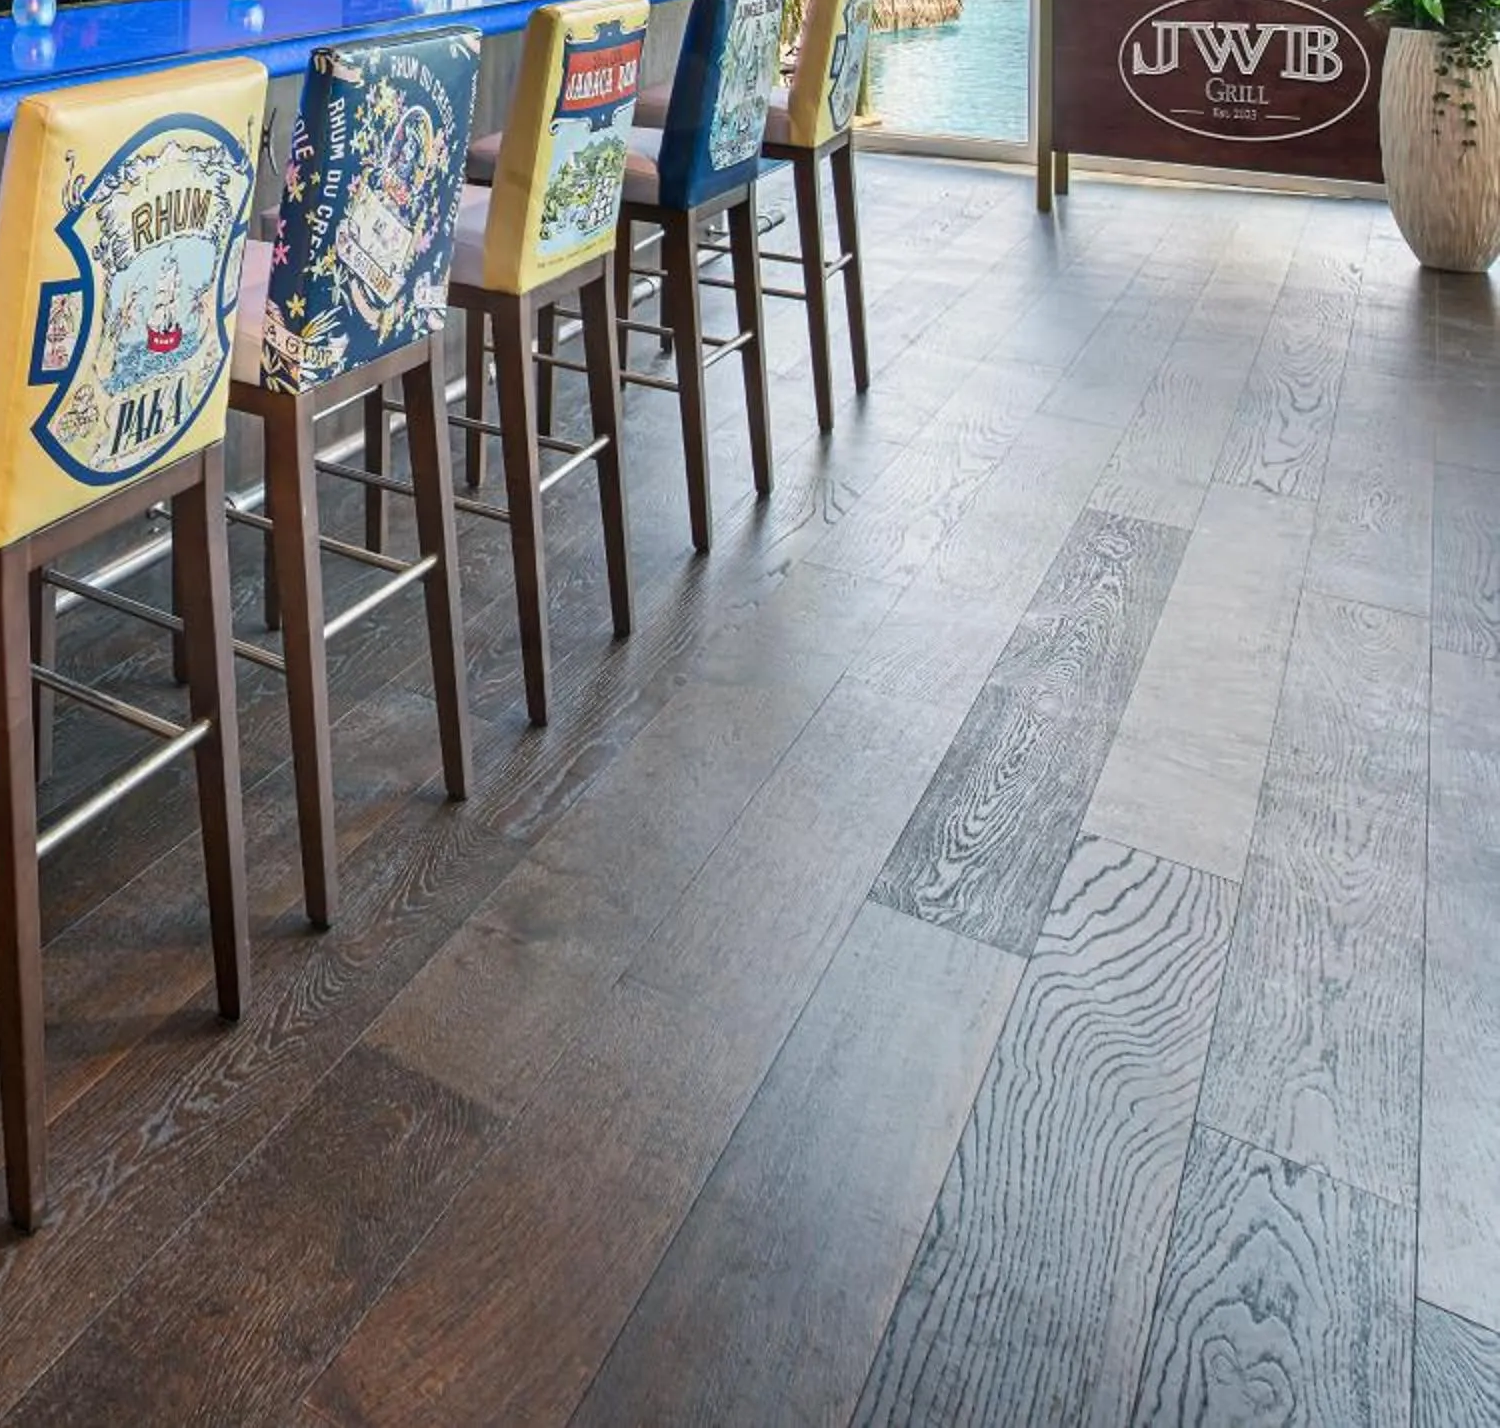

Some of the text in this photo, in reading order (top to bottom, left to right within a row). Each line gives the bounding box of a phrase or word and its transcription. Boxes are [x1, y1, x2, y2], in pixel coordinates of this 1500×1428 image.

[1133, 20, 1343, 83] JWB
[328, 96, 347, 161] RHUM
[323, 170, 343, 198] DU
[131, 187, 213, 253] RHUM
